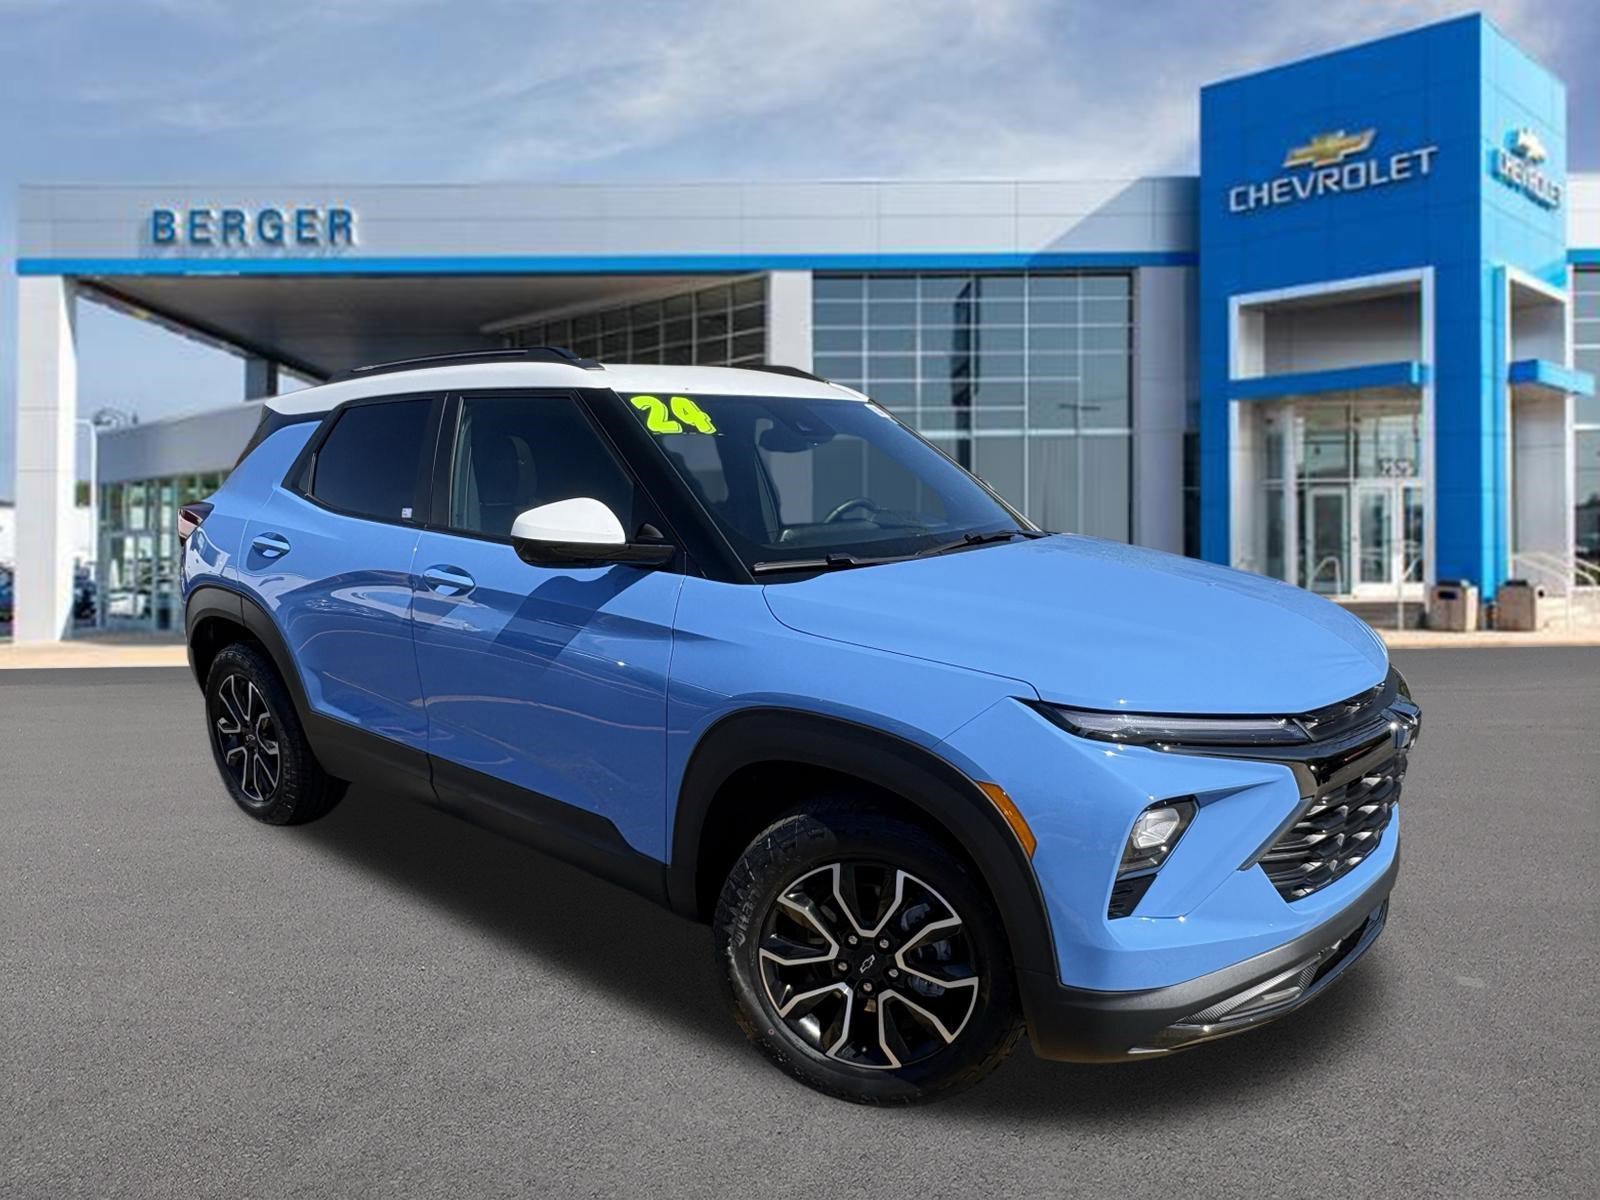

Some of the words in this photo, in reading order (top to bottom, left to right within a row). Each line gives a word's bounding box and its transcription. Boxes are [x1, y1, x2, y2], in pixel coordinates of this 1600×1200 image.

[1228, 145, 1439, 213] CHEVROLET
[151, 208, 357, 248] BERGER
[629, 394, 718, 434] 24
